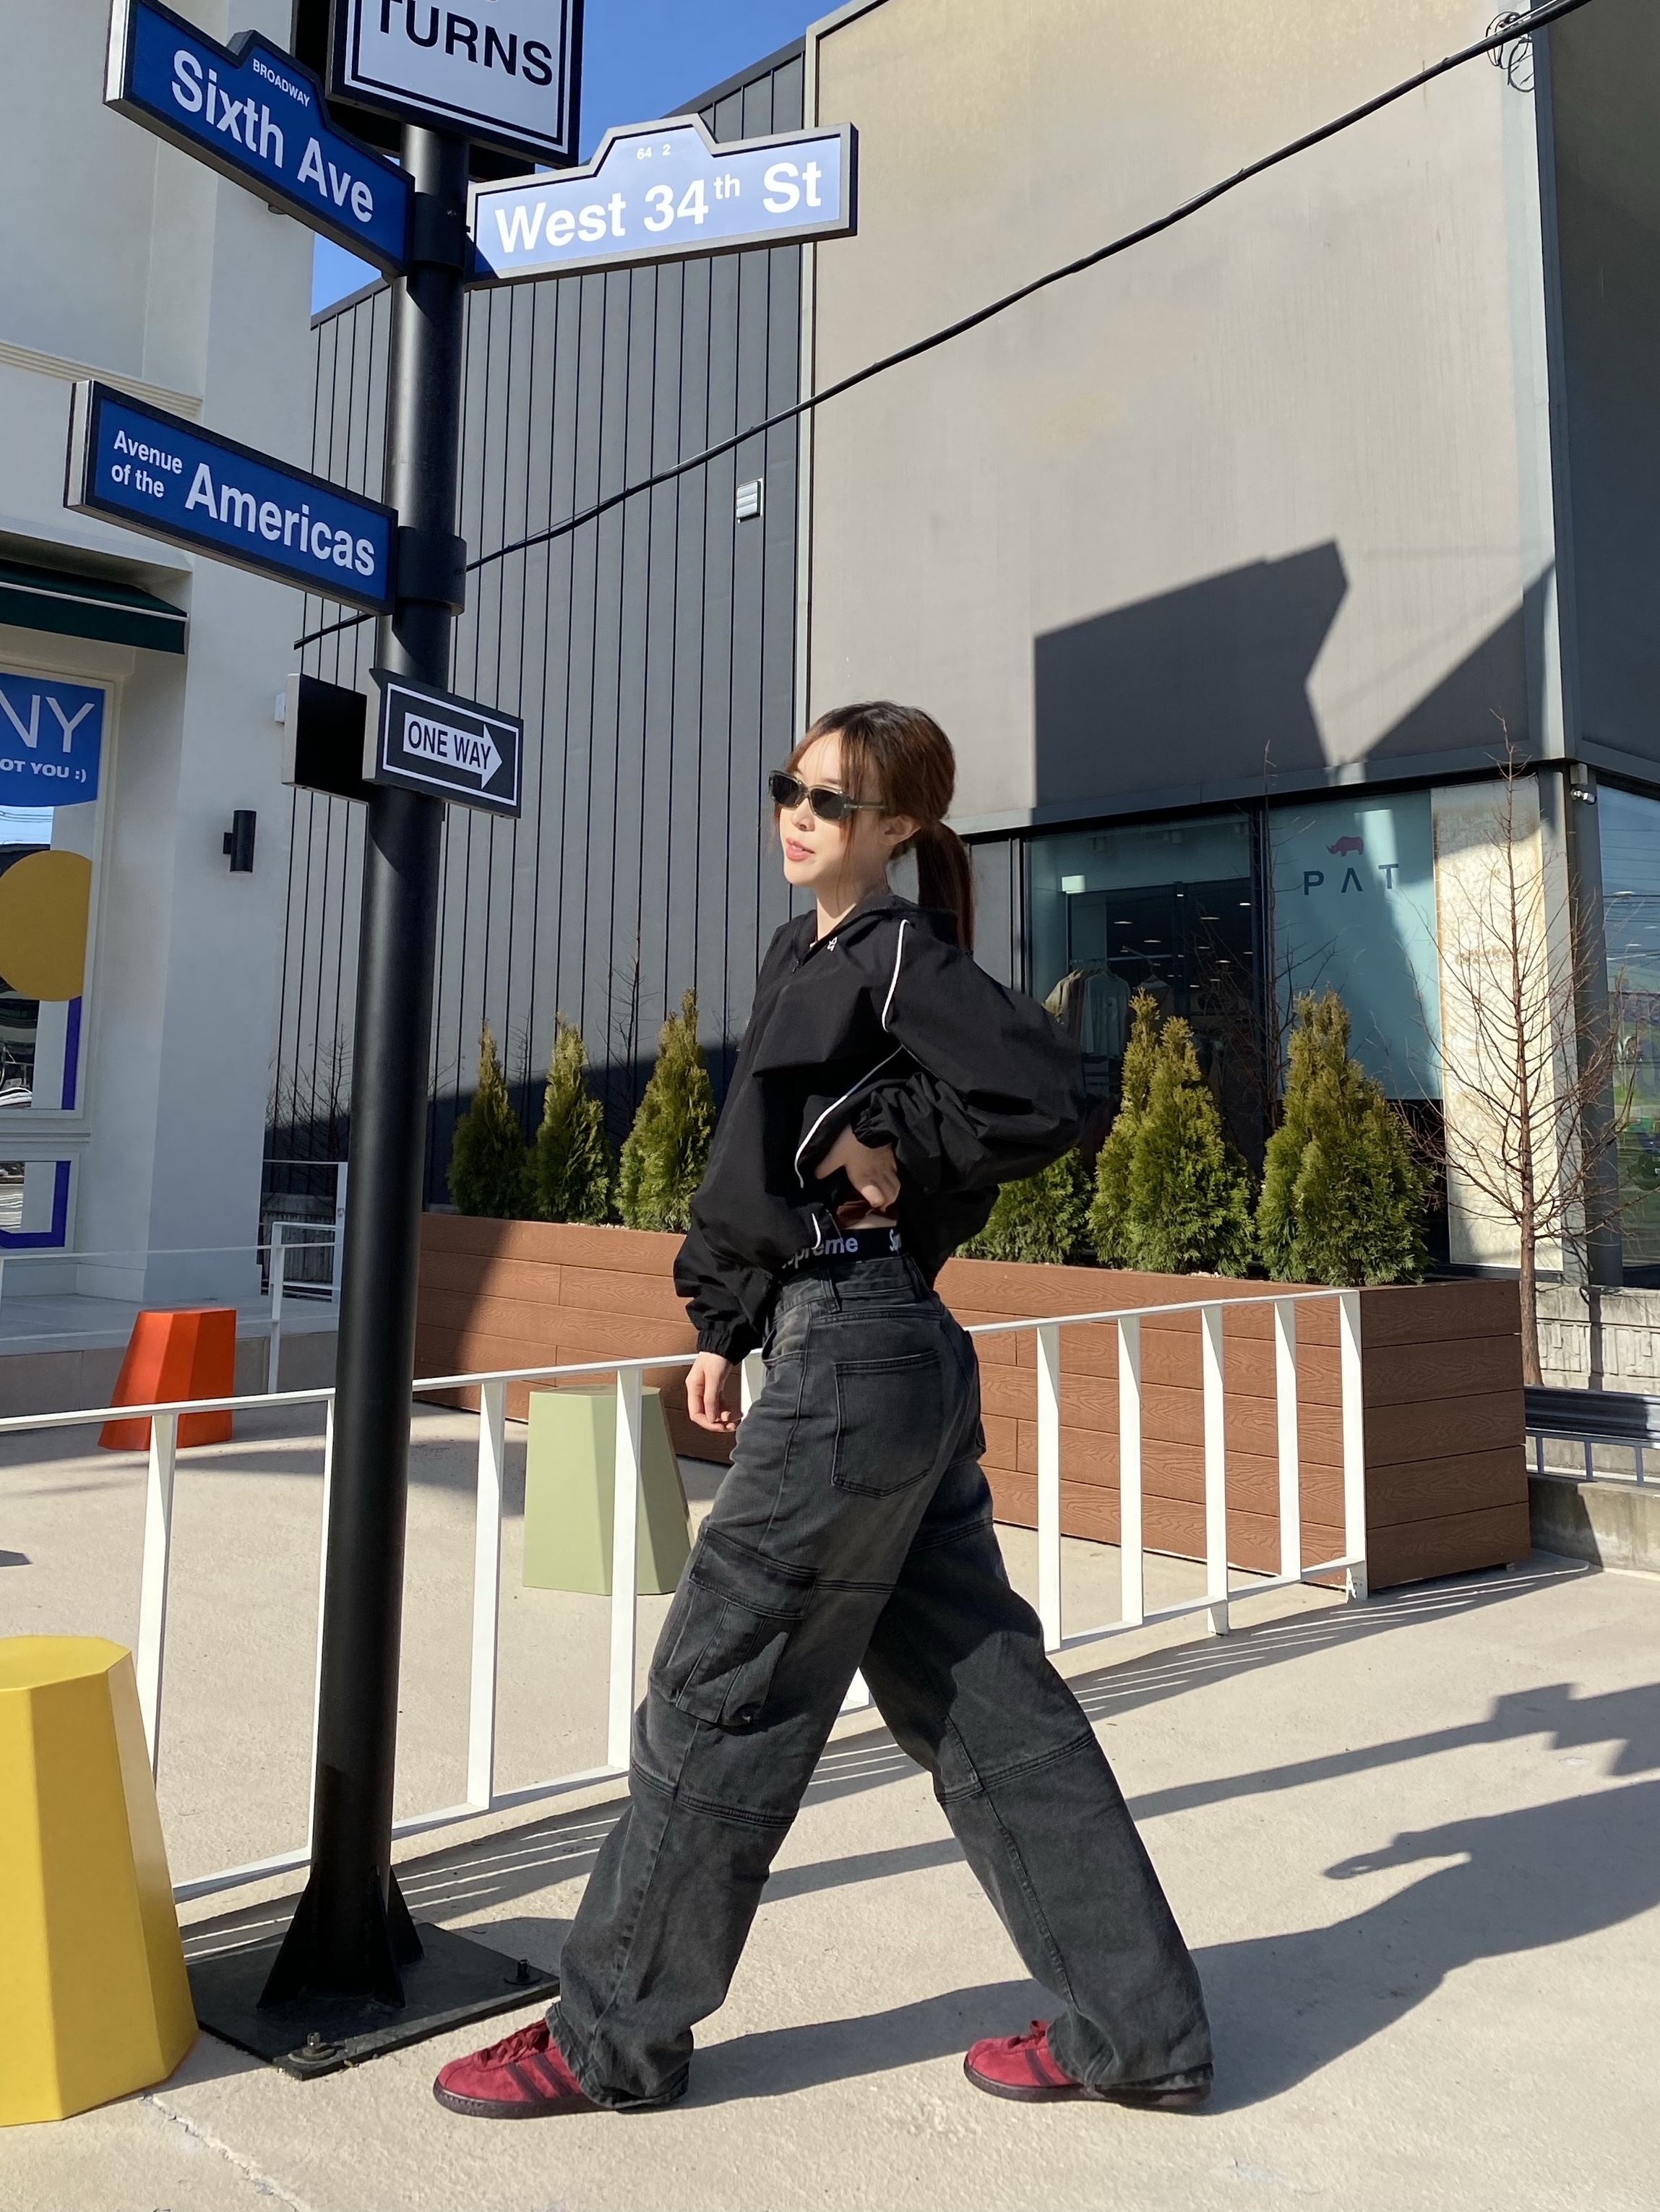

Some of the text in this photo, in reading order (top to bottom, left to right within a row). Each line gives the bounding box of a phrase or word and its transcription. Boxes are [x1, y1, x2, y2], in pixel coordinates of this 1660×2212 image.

[379, 0, 553, 86] TURNS
[252, 59, 311, 108] BROADWAY
[171, 48, 374, 223] Sixth Ave
[637, 143, 671, 160] 64 2
[495, 161, 822, 254] West 34th St
[113, 430, 183, 474] Avenue
[111, 464, 165, 498] of the
[185, 462, 376, 577] Americas
[408, 720, 491, 770] ONE WAY
[30, 762, 69, 778] YOU
[74, 768, 87, 783] :)
